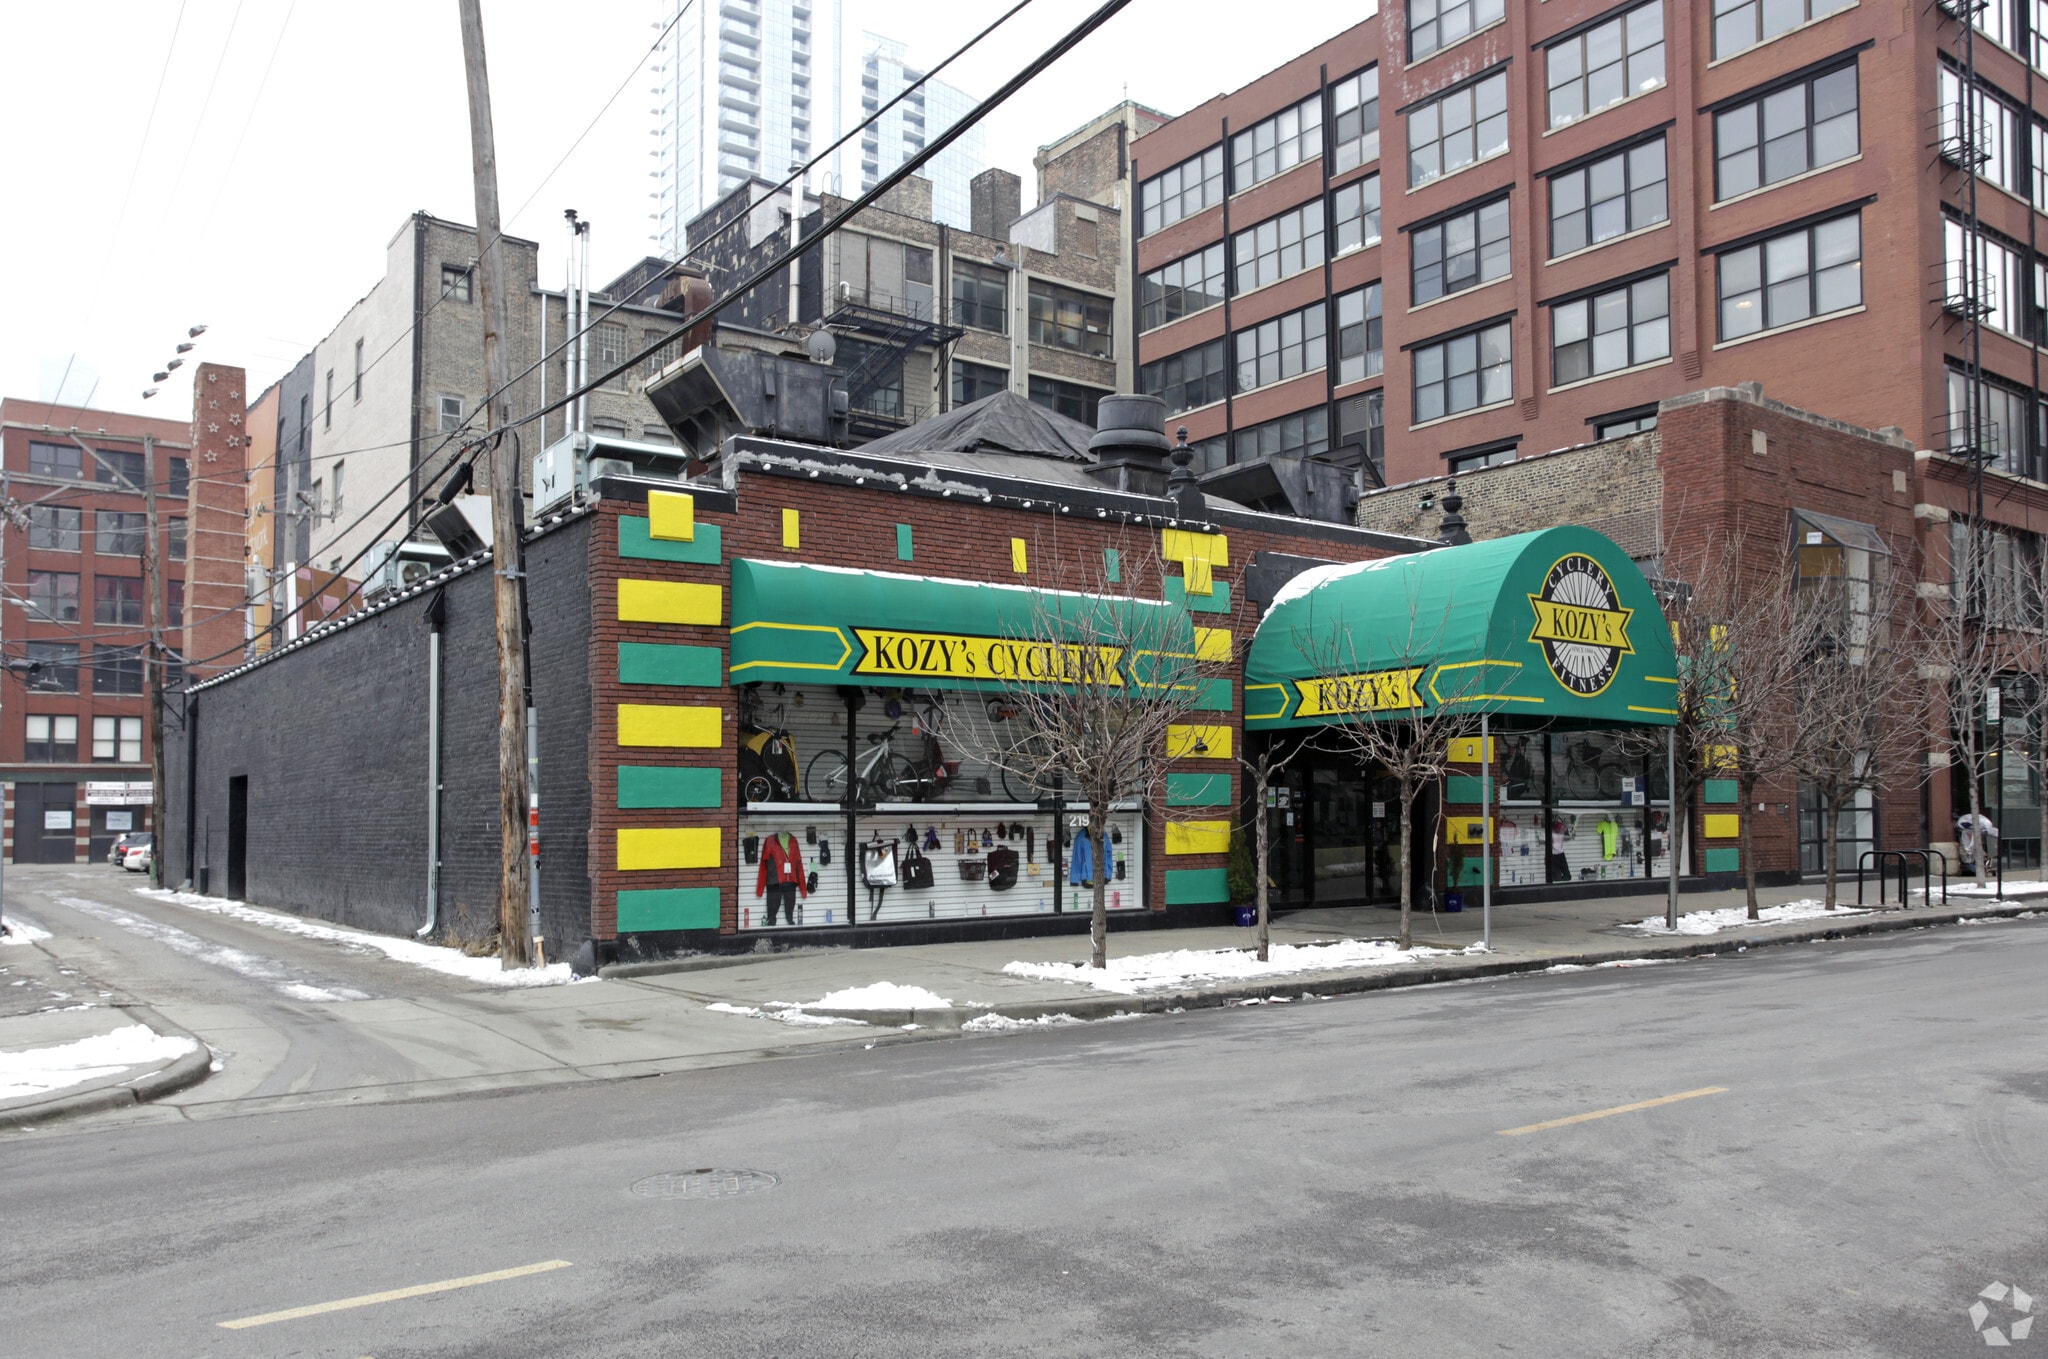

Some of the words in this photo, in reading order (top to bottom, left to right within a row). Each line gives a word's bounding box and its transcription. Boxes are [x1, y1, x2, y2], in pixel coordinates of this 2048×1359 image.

[1548, 557, 1613, 596] CYCLERY
[1552, 607, 1612, 642] KOZY's
[873, 635, 976, 674] KOZY's
[1318, 674, 1400, 711] KOZY's
[1552, 657, 1613, 692] FITNESS
[1069, 814, 1090, 827] 219
